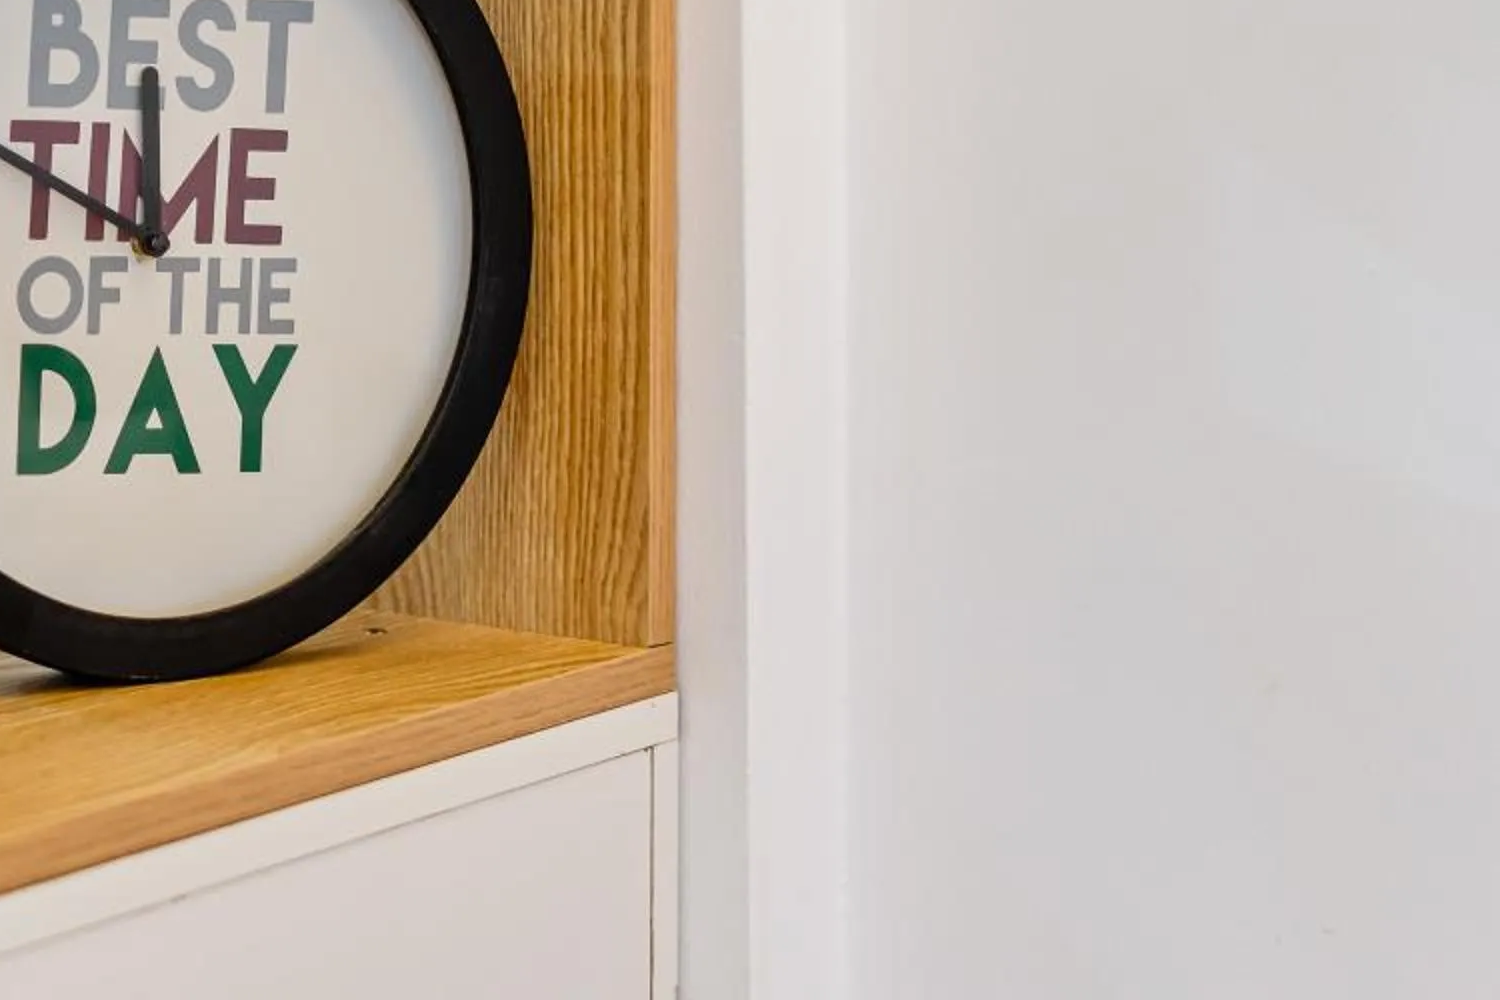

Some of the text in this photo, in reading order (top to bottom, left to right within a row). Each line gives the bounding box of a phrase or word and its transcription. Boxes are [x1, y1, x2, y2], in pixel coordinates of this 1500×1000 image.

[10, 119, 288, 246] TIME
[16, 256, 297, 335] OF THE
[16, 343, 298, 475] DAY
